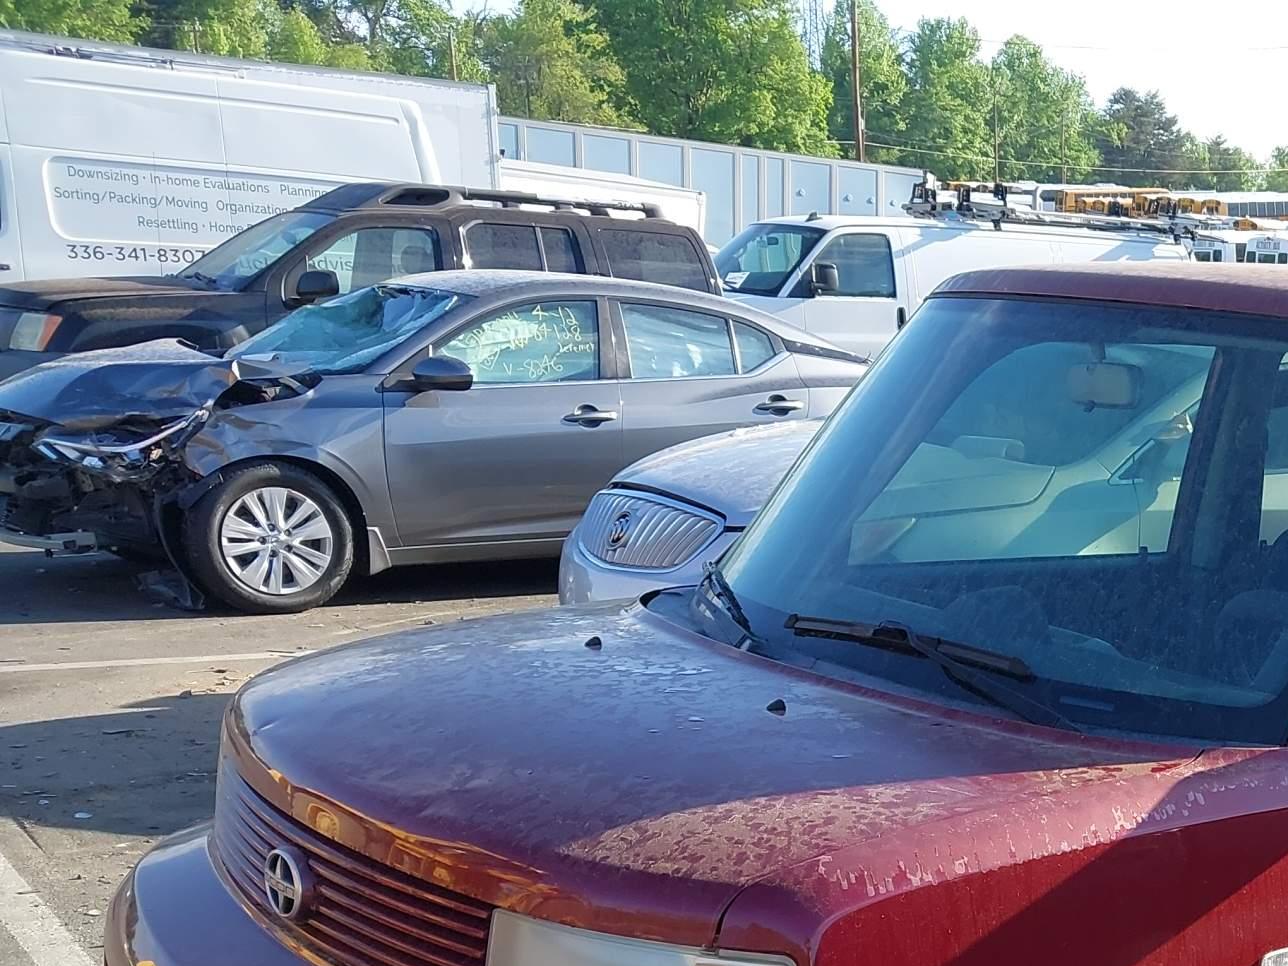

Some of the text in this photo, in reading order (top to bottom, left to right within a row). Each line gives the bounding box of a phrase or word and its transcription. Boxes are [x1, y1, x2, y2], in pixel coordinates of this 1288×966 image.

[67, 165, 139, 185] Downsizing
[149, 173, 200, 188] In-home
[203, 178, 270, 194] Evaluations
[54, 186, 208, 212] Sorting/Packing/Moving
[137, 216, 198, 233] Resettling
[209, 221, 243, 234] Home
